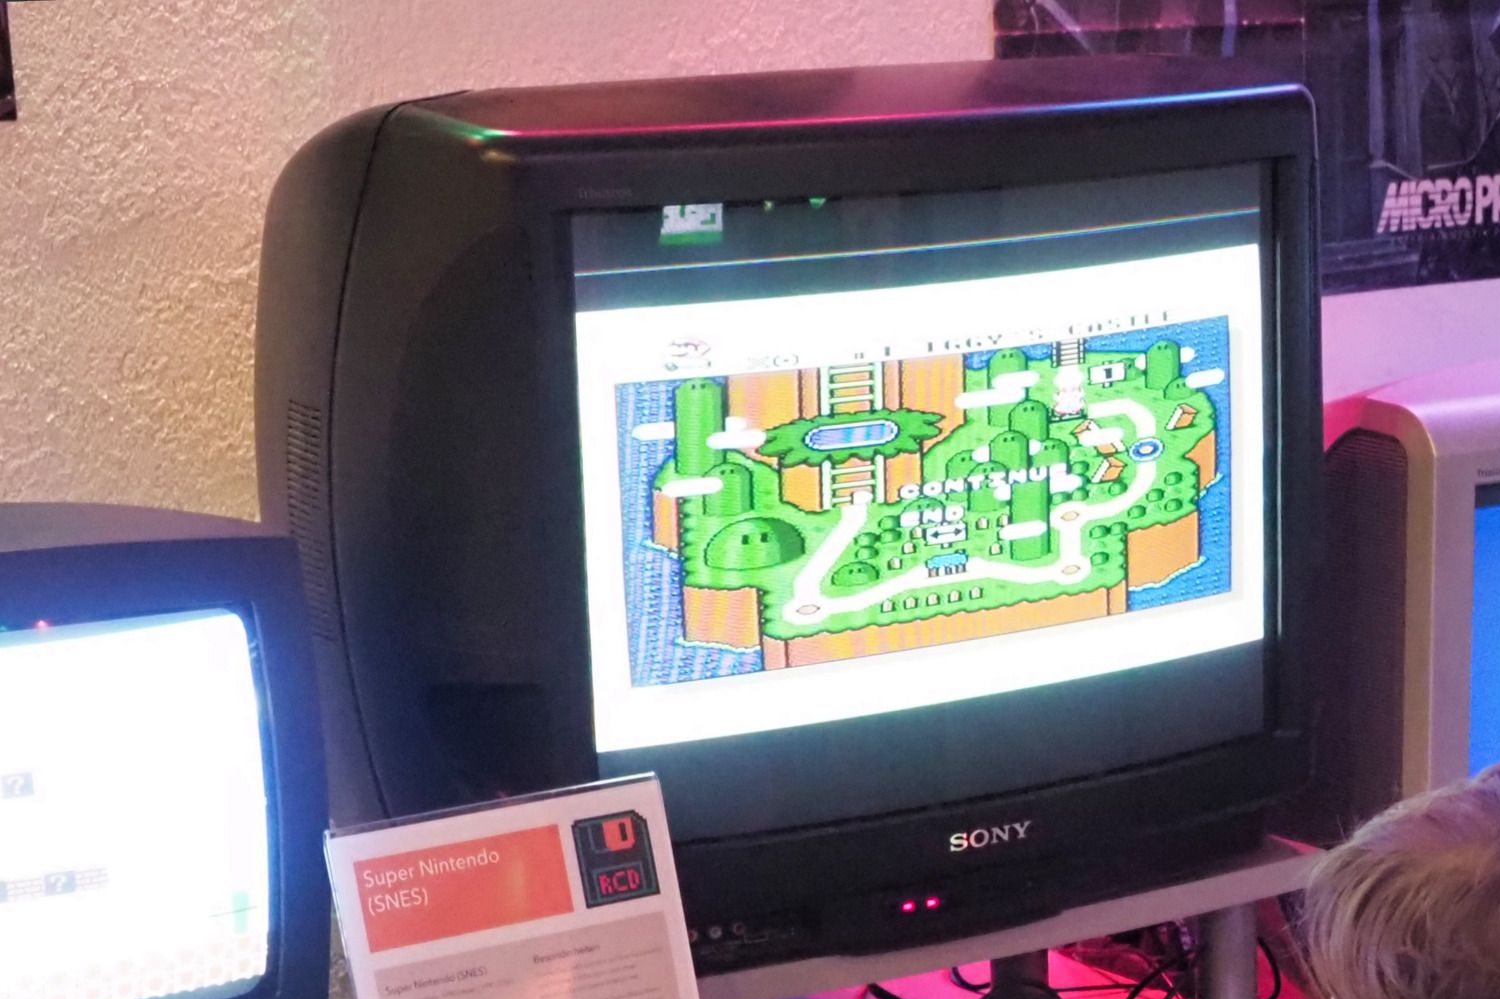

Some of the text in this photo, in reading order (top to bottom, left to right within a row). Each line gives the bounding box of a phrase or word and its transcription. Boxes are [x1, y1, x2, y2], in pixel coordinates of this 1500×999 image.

[949, 820, 1032, 852] SONY
[363, 848, 500, 889] Super Nintendo
[598, 866, 641, 896] RCD
[367, 887, 429, 916] (SNES)
